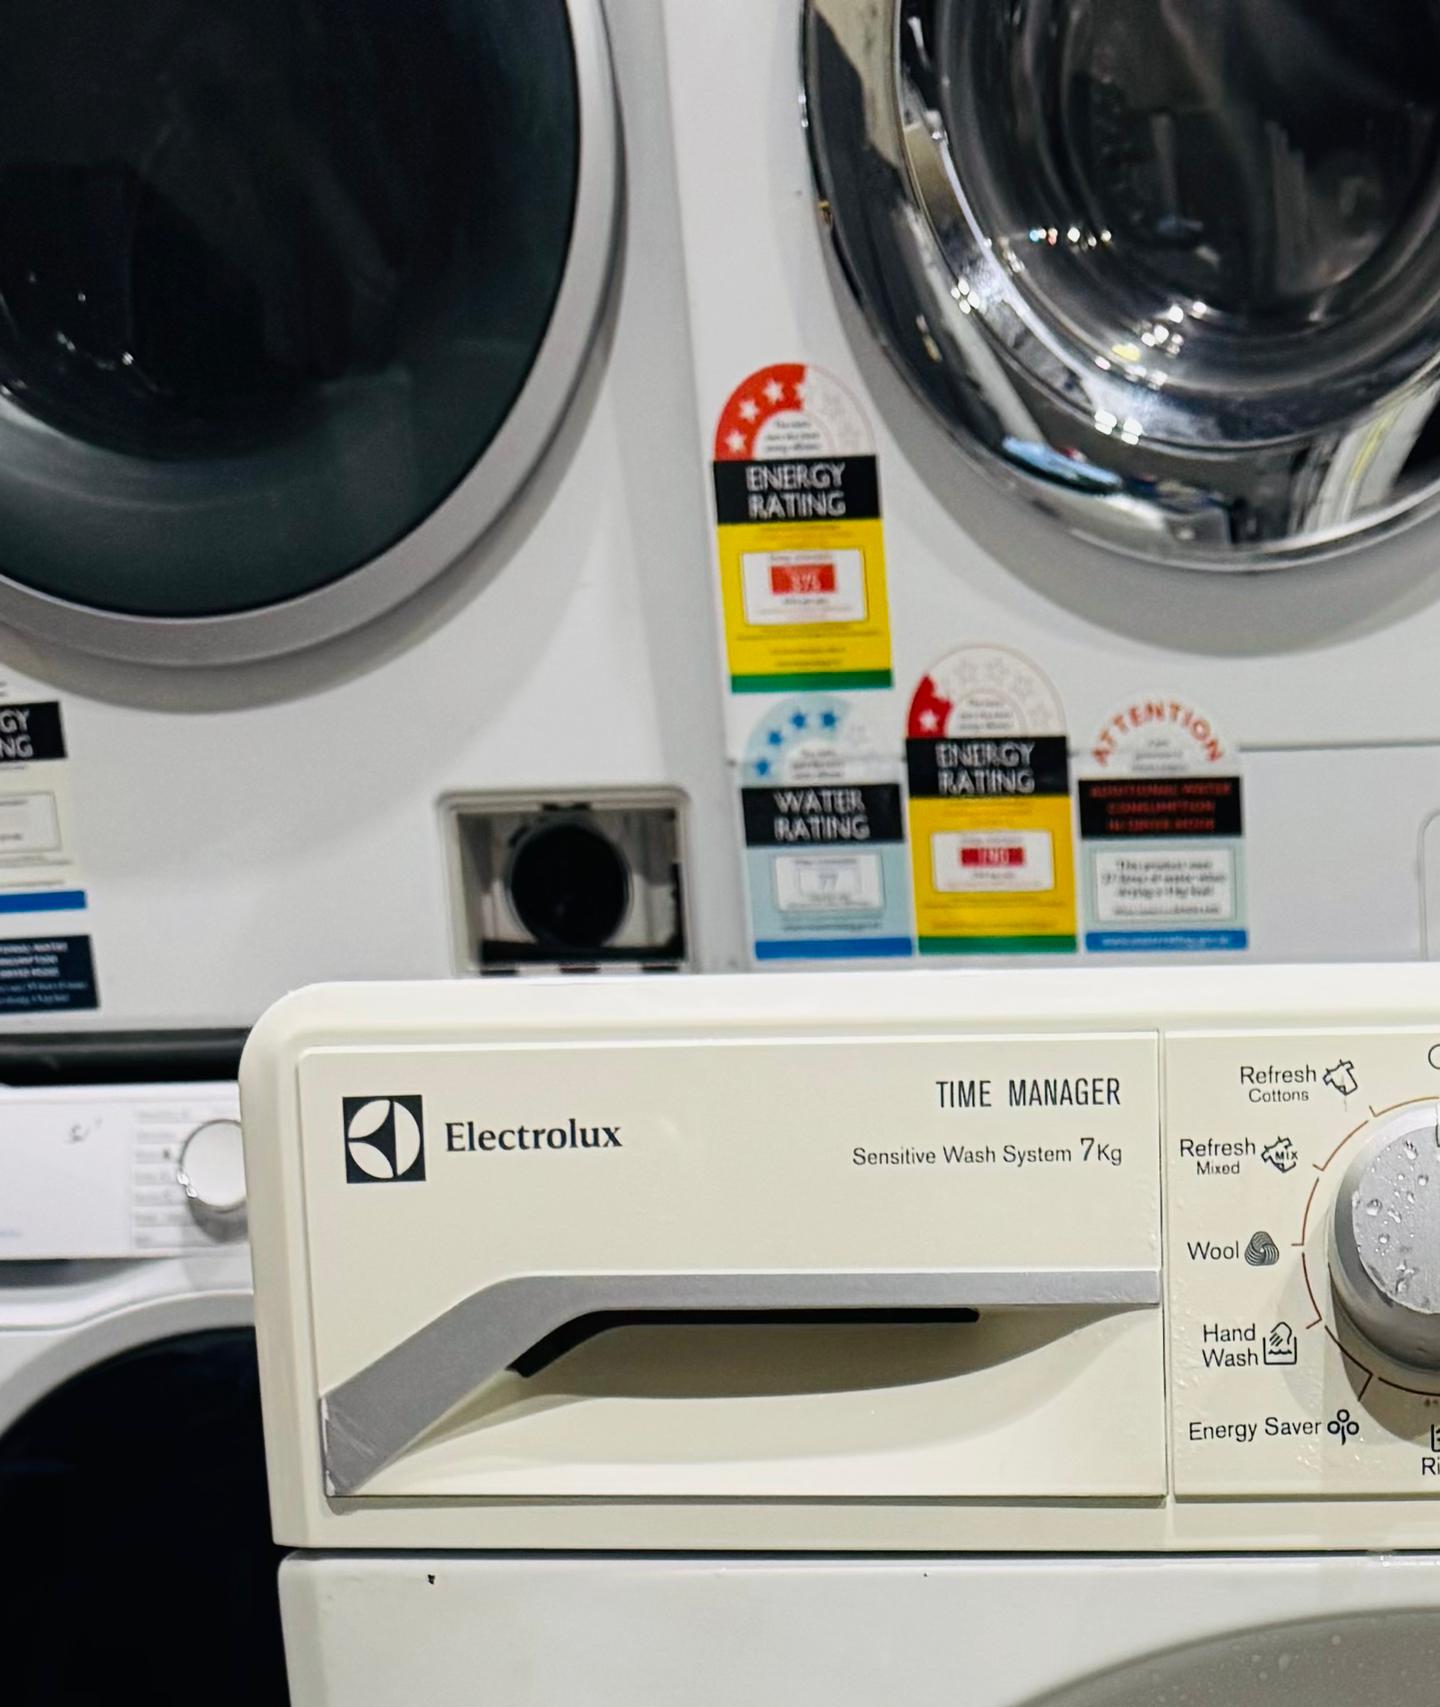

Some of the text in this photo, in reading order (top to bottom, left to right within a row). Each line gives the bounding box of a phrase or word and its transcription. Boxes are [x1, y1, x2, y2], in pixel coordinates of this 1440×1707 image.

[746, 463, 845, 491] ENERGY
[749, 491, 846, 519] RATING
[1092, 700, 1223, 767] ATTENTION
[935, 742, 1035, 767] ENERGY
[938, 768, 1035, 794] RATING
[773, 789, 866, 815] WATER
[774, 814, 870, 841] RATING
[1240, 1065, 1317, 1085] Refresh
[936, 1078, 1121, 1108] TIME MANAGER
[1248, 1088, 1310, 1103] Cottons
[445, 1118, 623, 1153] Electrolux
[1179, 1137, 1256, 1158] Refresh
[852, 1146, 936, 1166] Sensitive
[943, 1145, 996, 1164] Wash
[1003, 1144, 1072, 1168] System
[1275, 1150, 1298, 1161] MIX
[1196, 1161, 1240, 1175] Mixed
[1187, 1240, 1240, 1260] Wool
[1202, 1324, 1256, 1343] Hand
[1202, 1348, 1259, 1368] Wash
[1189, 1418, 1322, 1442] Energy Saver
